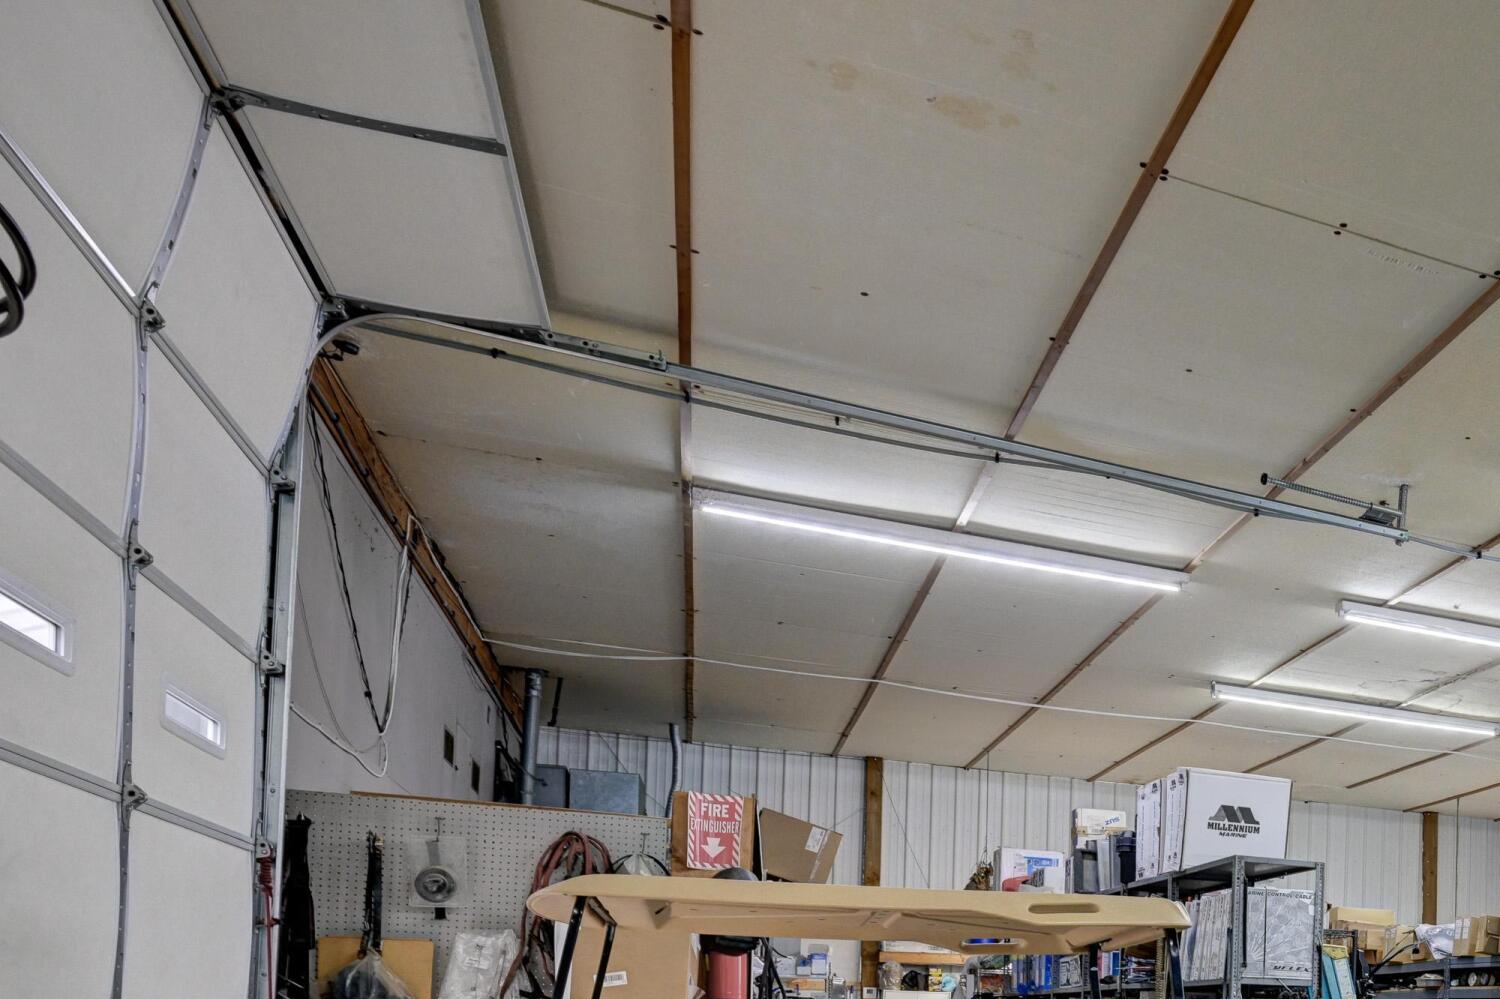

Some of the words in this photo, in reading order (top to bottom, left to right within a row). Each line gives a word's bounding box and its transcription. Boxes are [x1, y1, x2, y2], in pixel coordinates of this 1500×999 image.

[700, 802, 730, 818] FIRE
[690, 817, 740, 834] EXTINGUISHER
[1207, 821, 1261, 834] MILLENNIUM
[1218, 831, 1248, 839] MARINE
